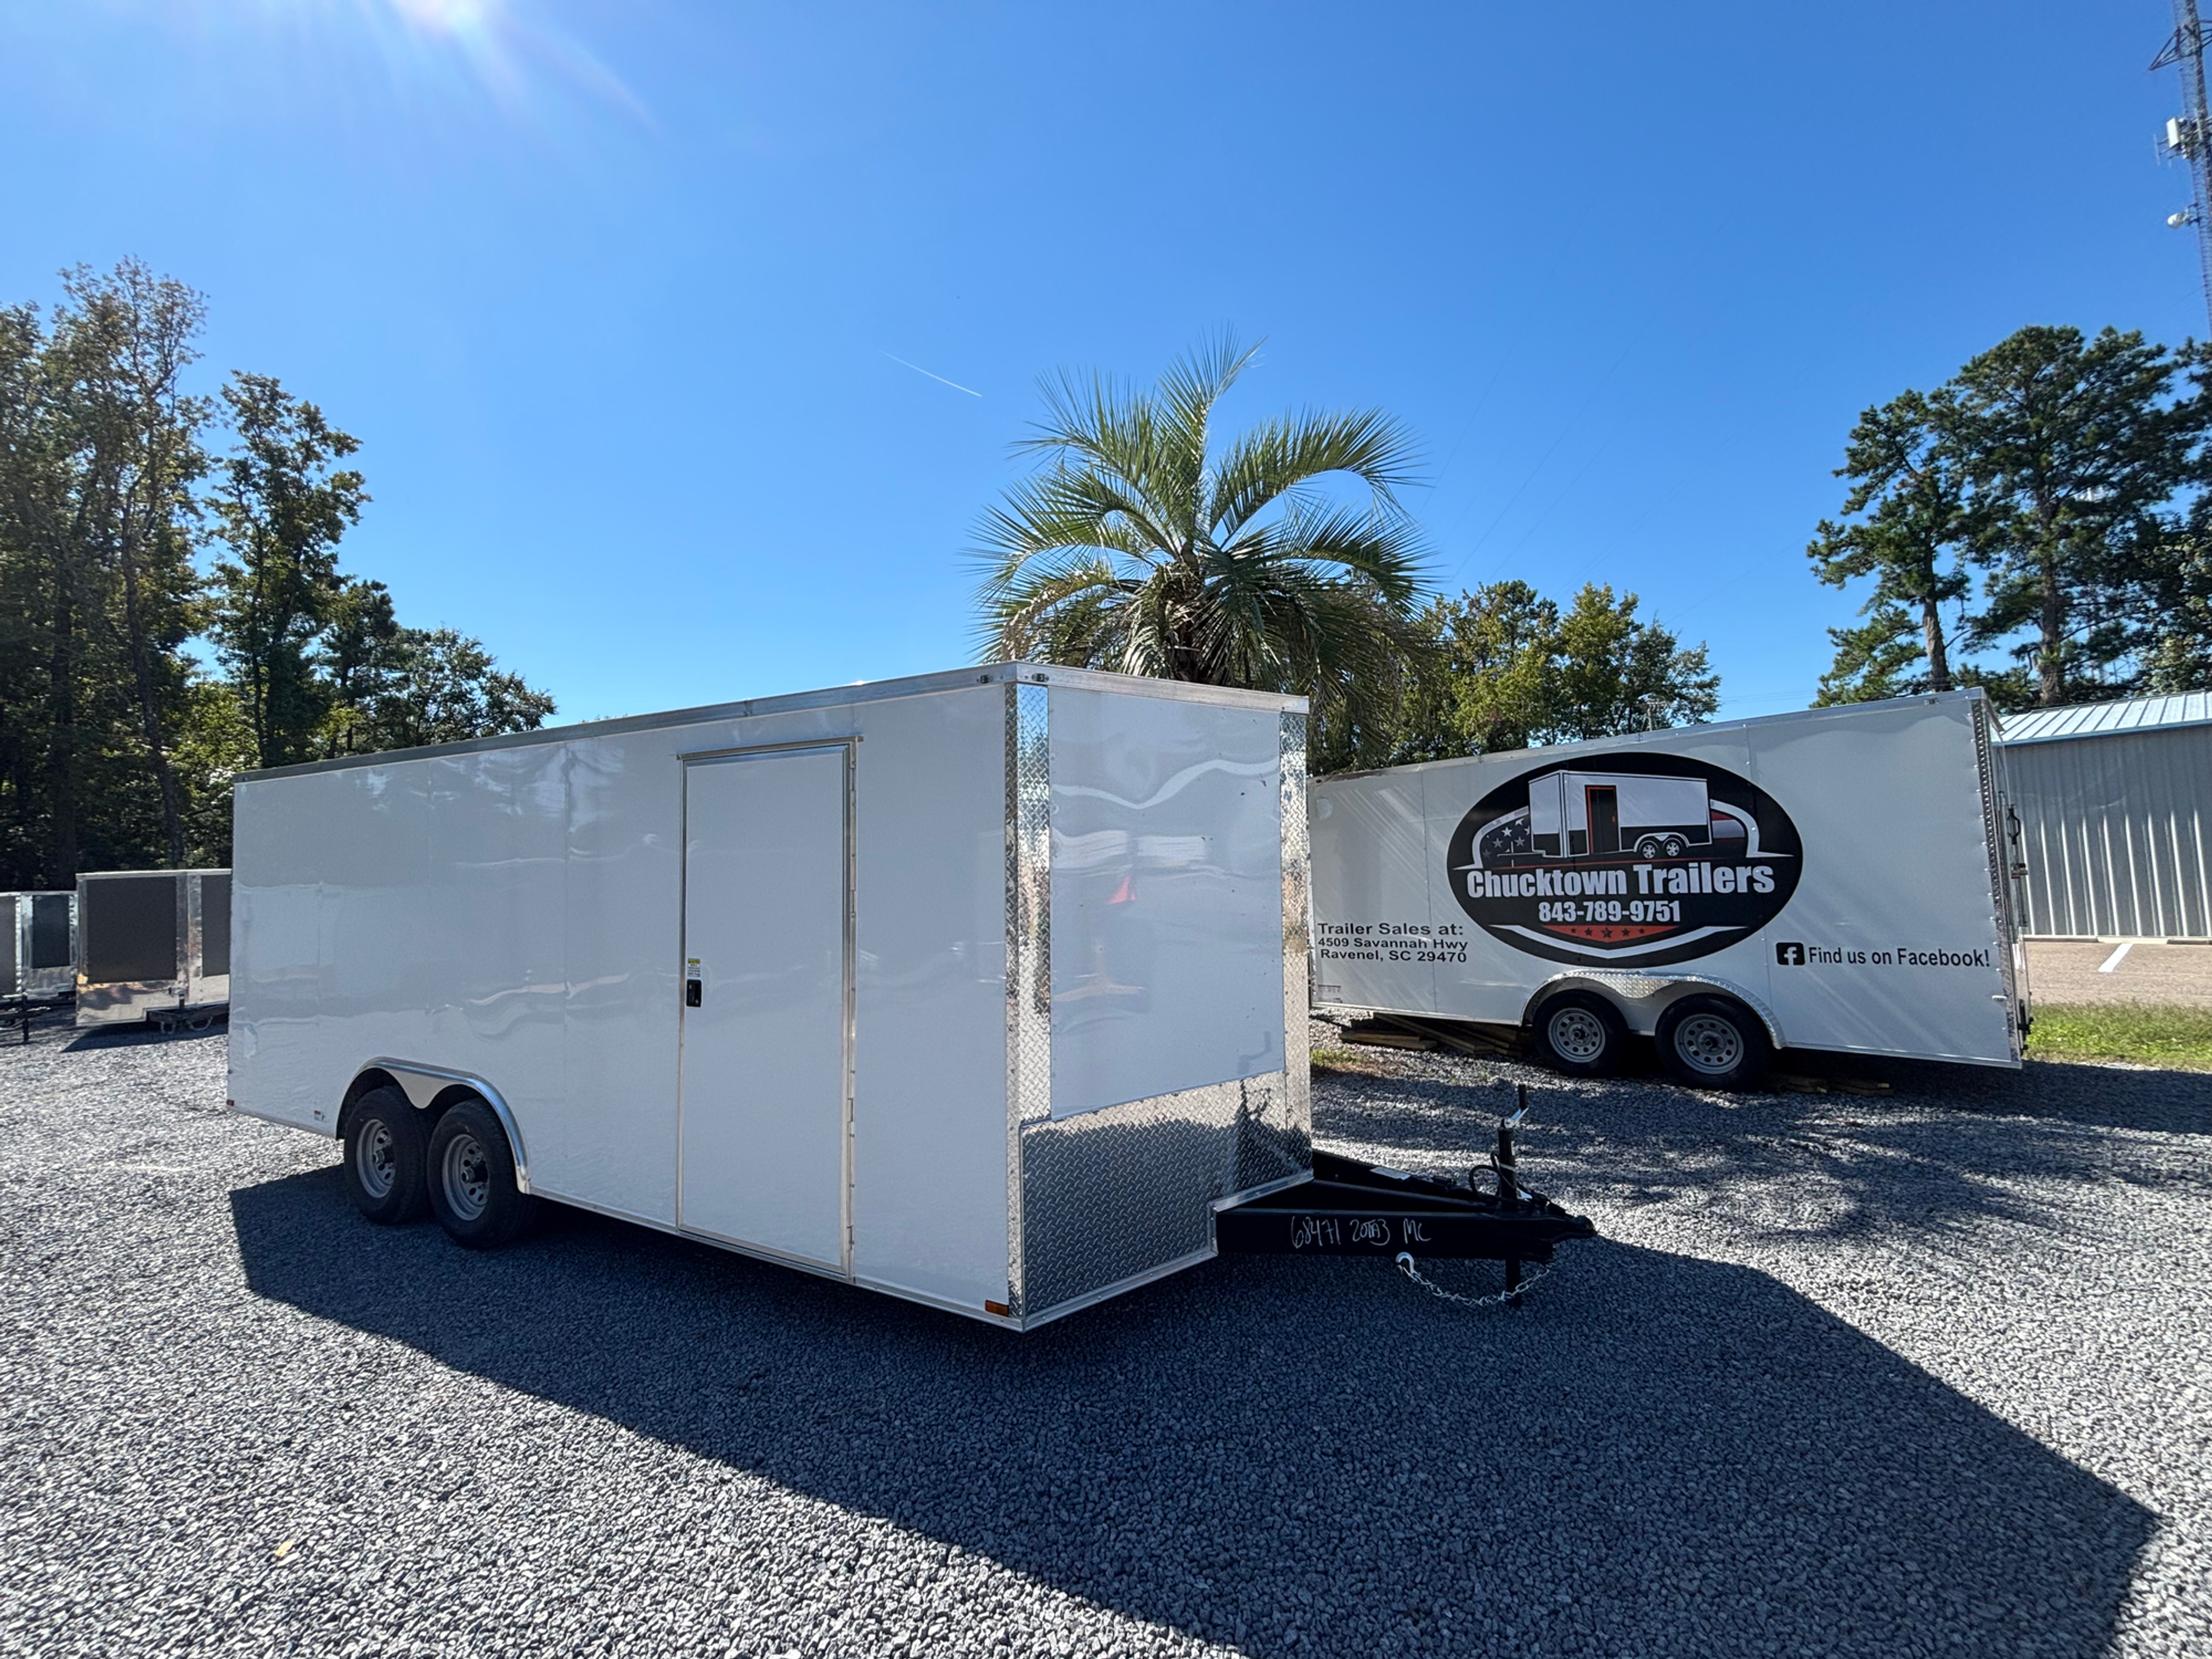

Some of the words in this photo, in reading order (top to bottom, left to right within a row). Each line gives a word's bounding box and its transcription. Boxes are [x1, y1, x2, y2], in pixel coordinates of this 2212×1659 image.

[1467, 868, 1627, 898] Chucktown
[1633, 862, 1775, 894] Trailers
[1538, 900, 1681, 922] 843-789-9751
[1318, 923, 1373, 935] Trailer
[1379, 922, 1431, 935] Sales
[1438, 923, 1464, 935] at:
[1318, 938, 1349, 947] 4509
[1353, 938, 1427, 949] Savannah
[1433, 939, 1468, 952] Hwy
[1321, 949, 1384, 962] Ravenel,
[1389, 950, 1411, 961] SC
[1417, 951, 1467, 963] 29470
[1808, 947, 1842, 963] Find
[1847, 950, 1866, 964] us
[1871, 951, 1892, 964] on
[1897, 947, 1990, 967] Facebook!
[1403, 1218, 1432, 1245] MC
